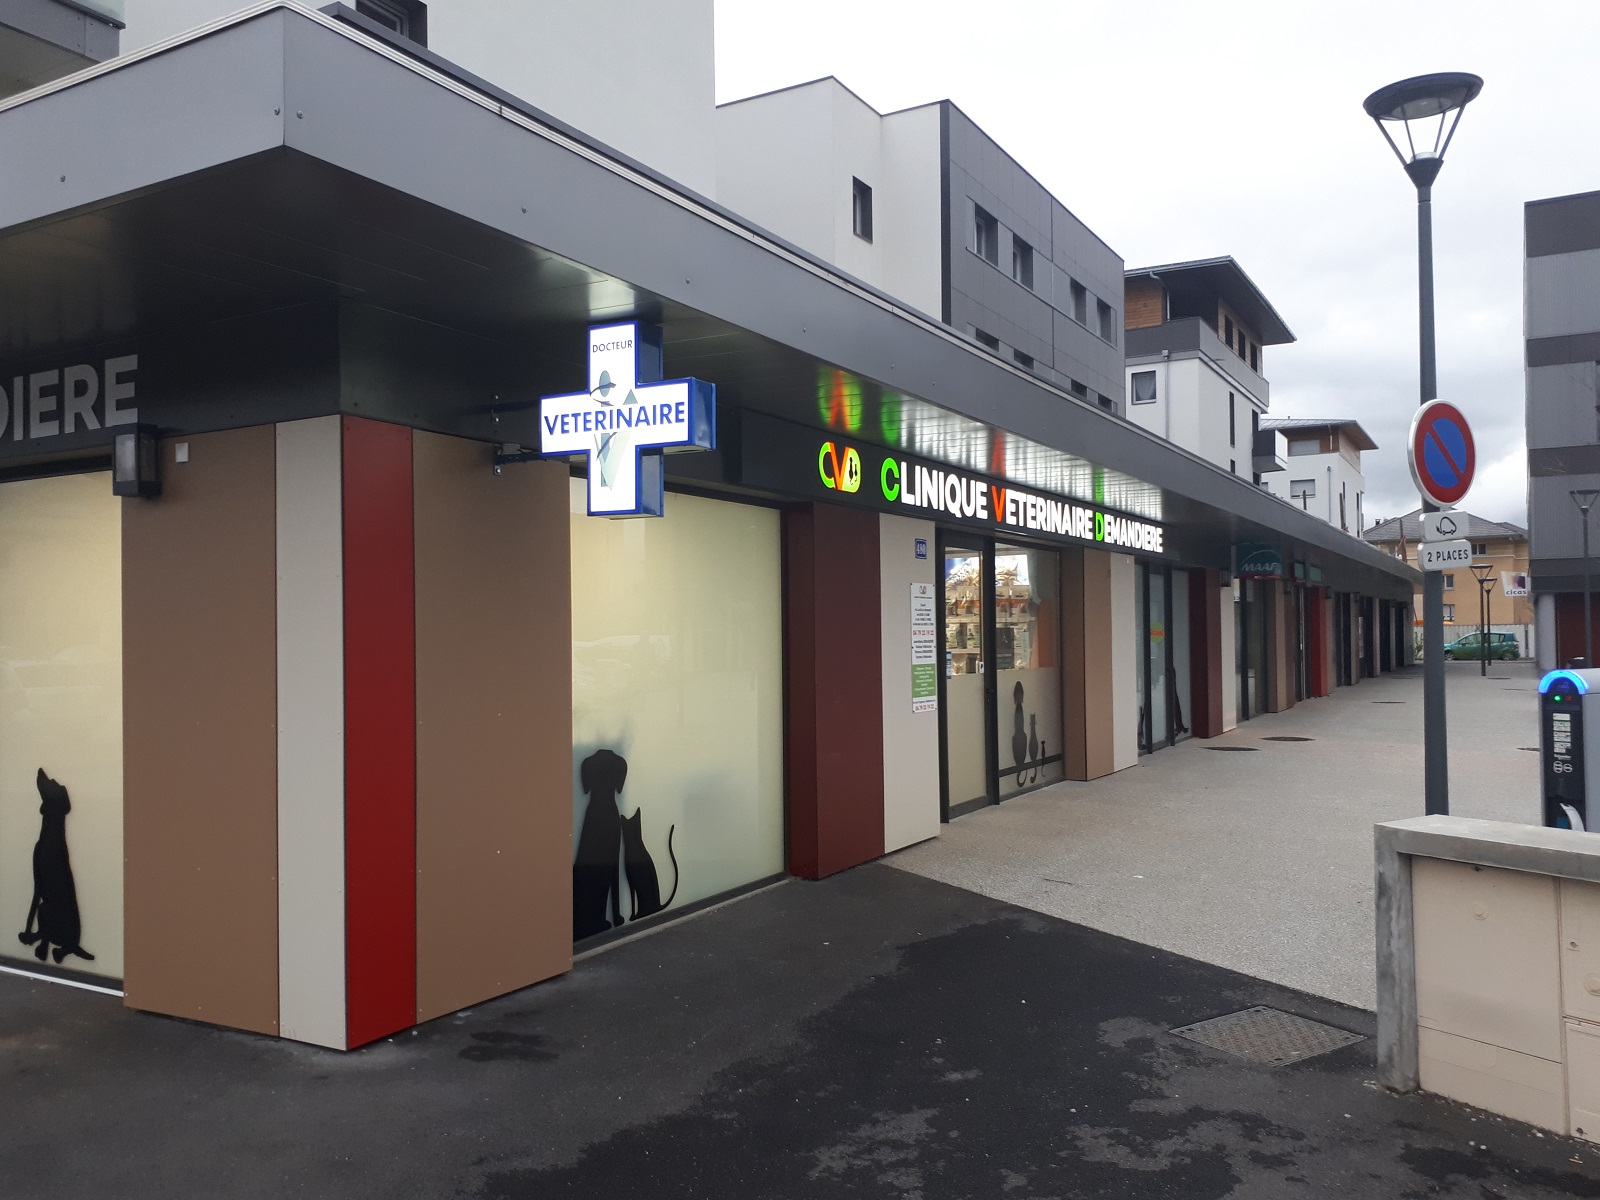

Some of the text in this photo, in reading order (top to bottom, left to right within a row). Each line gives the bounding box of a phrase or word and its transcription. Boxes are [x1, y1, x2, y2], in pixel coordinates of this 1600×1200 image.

[592, 339, 633, 353] DOCTEUR
[0, 354, 138, 441] IERE
[543, 402, 686, 435] VETERINAIRE
[880, 457, 1164, 554] CLINIQUE VETERINAIRE DEMANDIERE
[1241, 562, 1278, 571] MAAF
[1427, 549, 1469, 562] 2 PLACES
